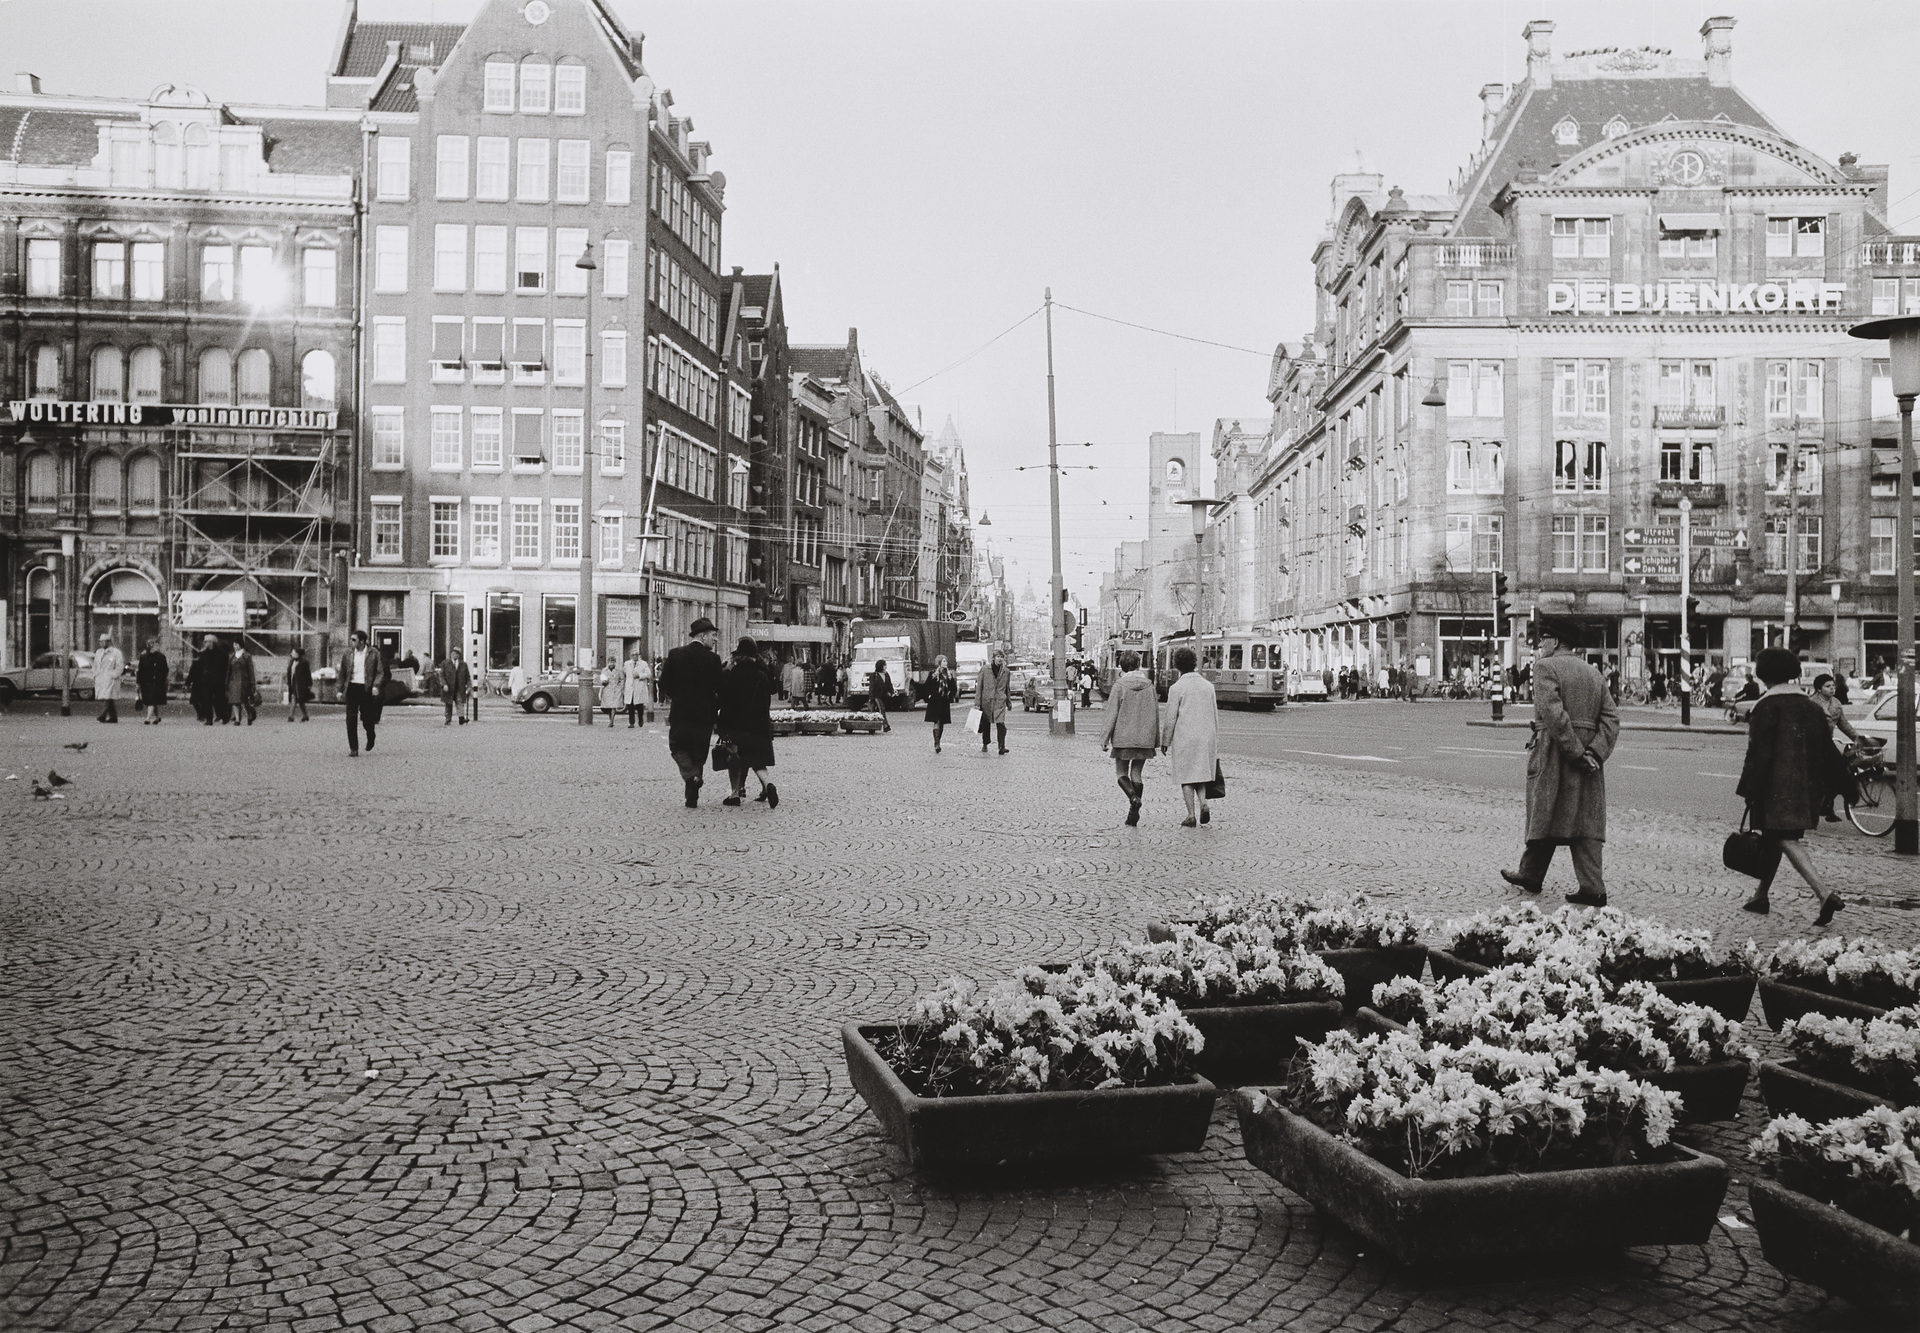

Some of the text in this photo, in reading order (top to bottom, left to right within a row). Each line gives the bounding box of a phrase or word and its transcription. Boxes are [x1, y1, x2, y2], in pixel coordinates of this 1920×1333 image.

[1548, 283, 1606, 311] DE
[10, 401, 338, 430] WOLTERING woninginrichting
[1644, 529, 1675, 537] Utrecht
[1642, 537, 1676, 545] Haarlem
[1714, 537, 1735, 546] Noord
[1641, 556, 1672, 566] Schiphol
[1642, 565, 1676, 575] Den Haag
[1124, 630, 1137, 641] 24
